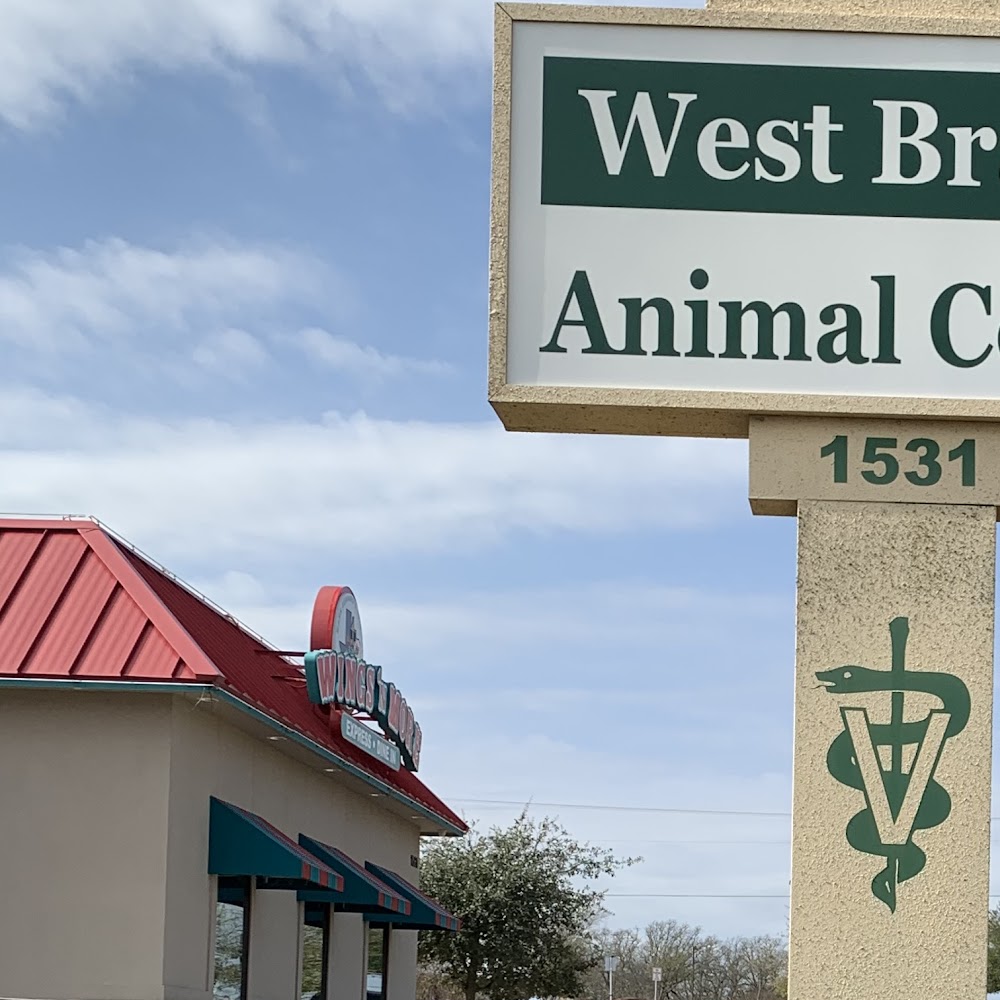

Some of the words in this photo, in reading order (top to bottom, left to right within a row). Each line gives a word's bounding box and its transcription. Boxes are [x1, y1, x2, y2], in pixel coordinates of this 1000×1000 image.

[578, 90, 843, 184] West
[539, 269, 901, 364] Animal
[821, 435, 976, 486] 1531
[316, 651, 375, 713] WINGS
[346, 720, 372, 749] EXPRESS
